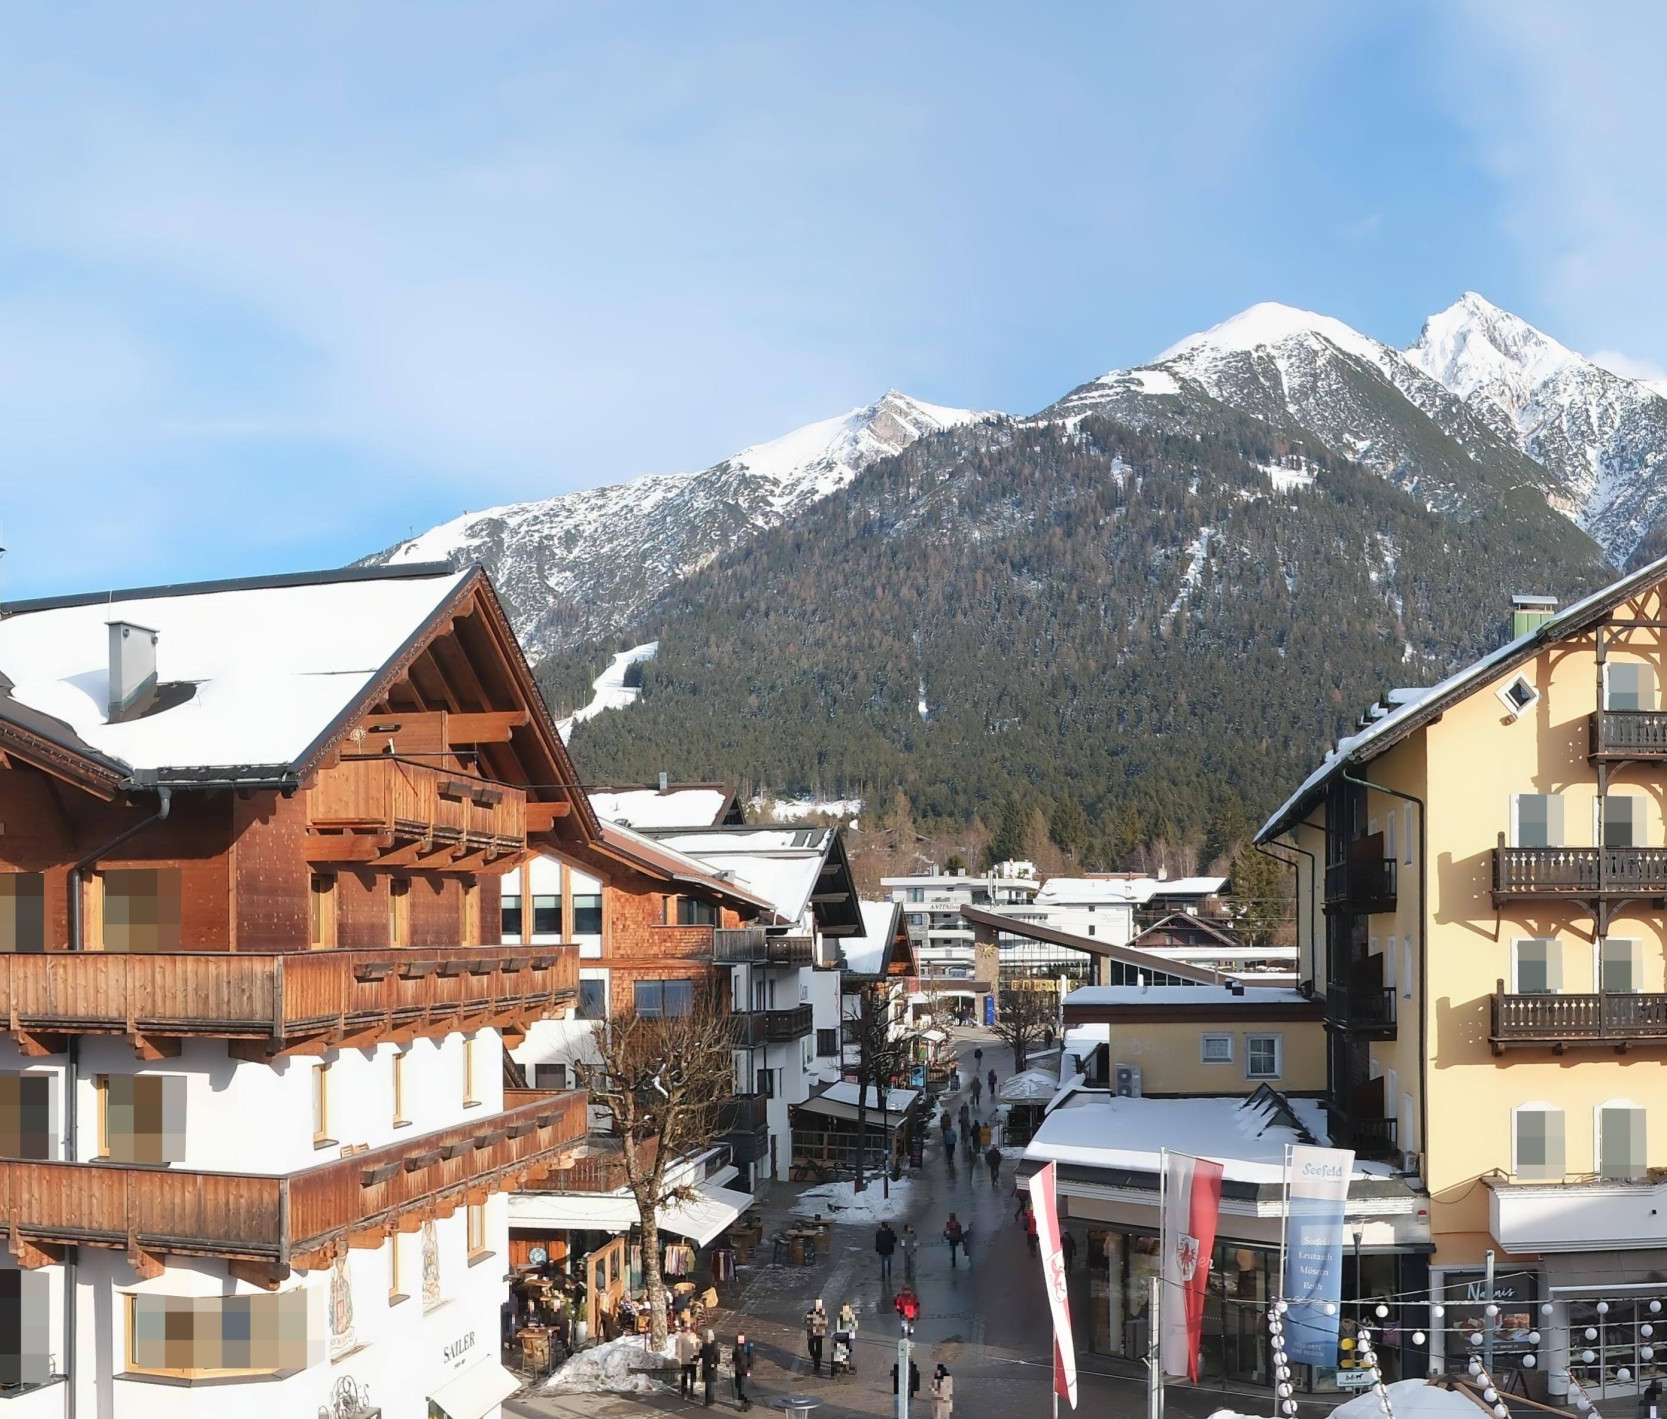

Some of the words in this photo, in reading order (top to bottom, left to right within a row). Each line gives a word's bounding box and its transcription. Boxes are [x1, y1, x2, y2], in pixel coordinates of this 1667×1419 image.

[1302, 1162, 1342, 1178] Seefeld
[1467, 1283, 1515, 1300] Nanis
[444, 1331, 475, 1363] SAILER
